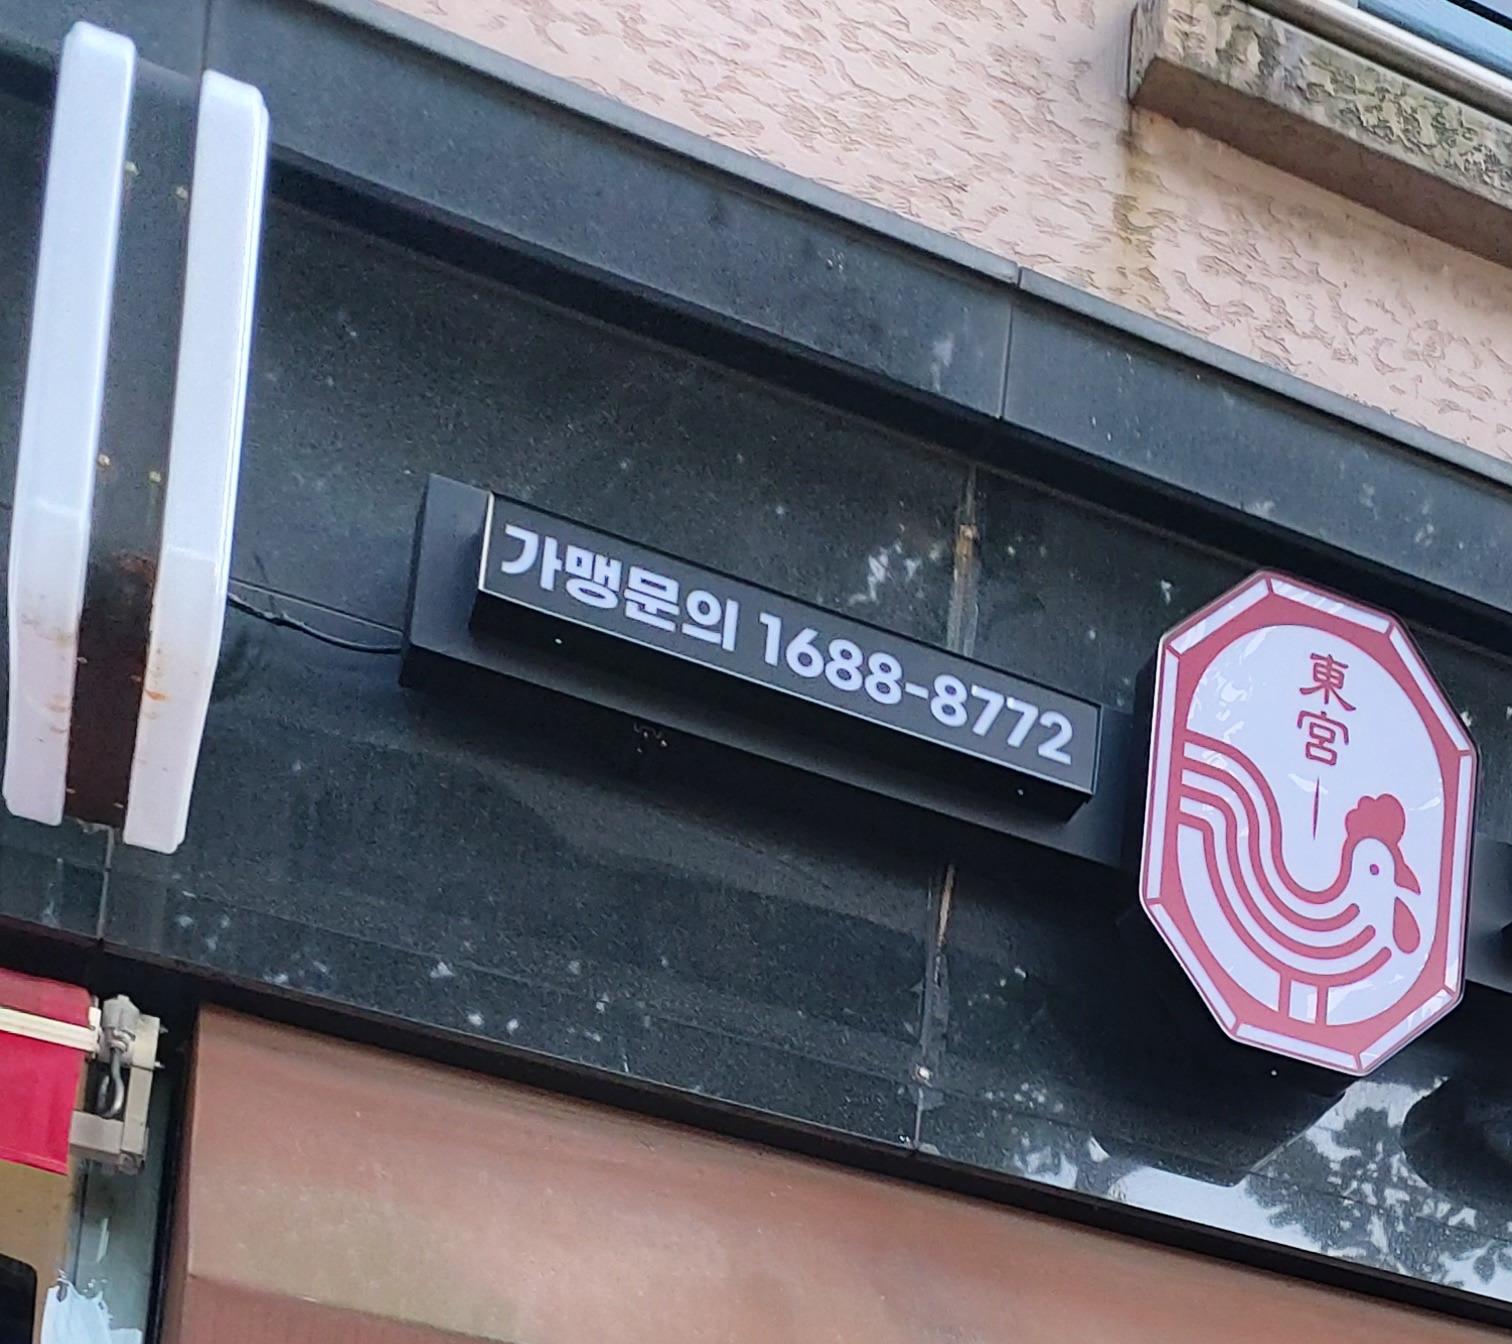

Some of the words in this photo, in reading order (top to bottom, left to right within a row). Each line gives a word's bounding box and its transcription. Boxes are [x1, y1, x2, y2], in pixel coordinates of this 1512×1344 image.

[501, 524, 738, 652] 가맹문의
[758, 612, 1073, 765] 1688-8772
[1296, 652, 1357, 767] 東宮
